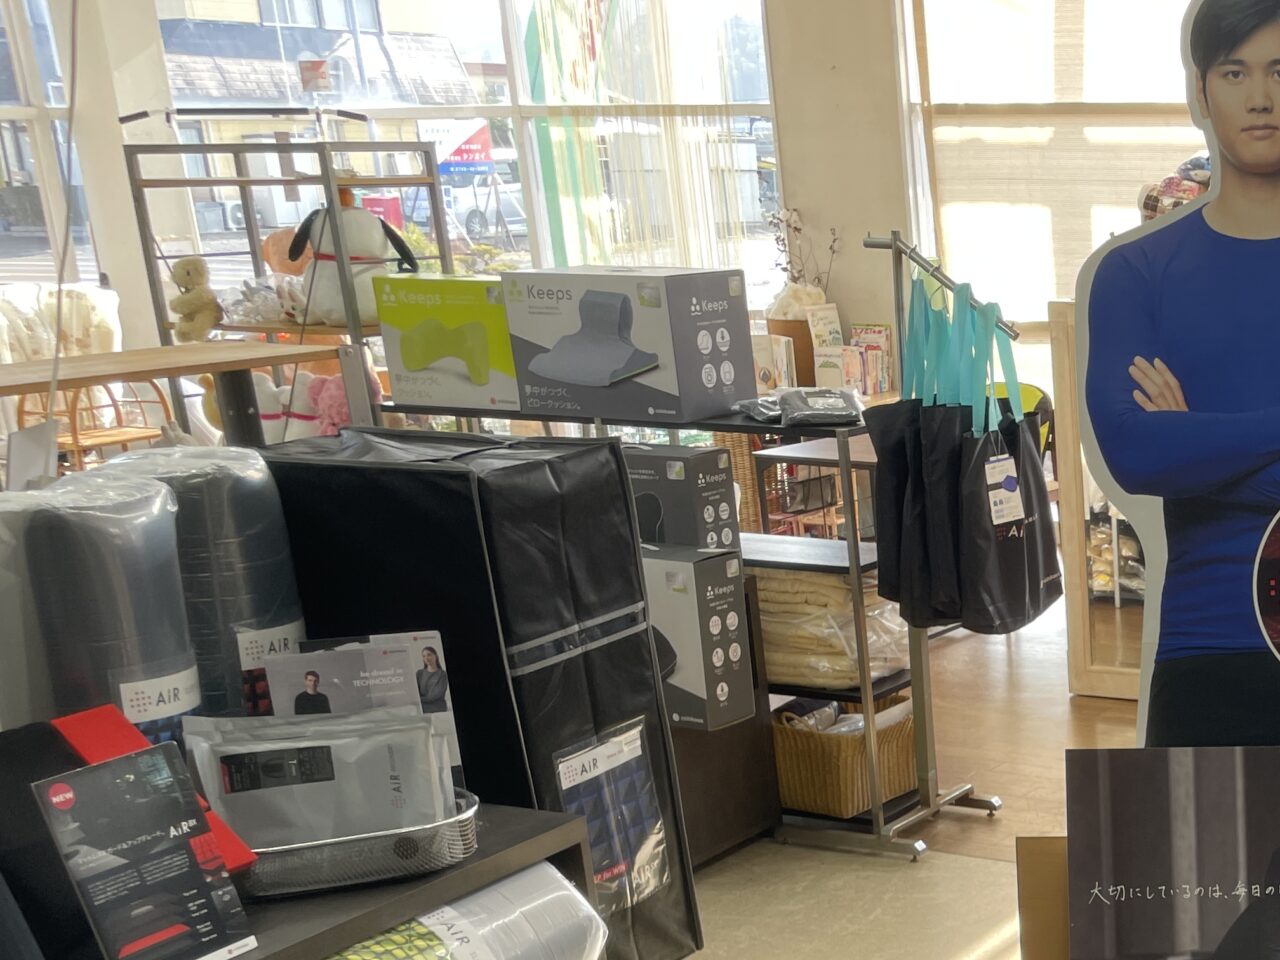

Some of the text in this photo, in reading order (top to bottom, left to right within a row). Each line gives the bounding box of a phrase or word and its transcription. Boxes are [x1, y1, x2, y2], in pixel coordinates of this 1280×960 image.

[399, 289, 442, 309] Keeps
[526, 284, 573, 304] Keeps
[701, 300, 729, 312] Keeps
[705, 473, 727, 484] Keeps
[714, 583, 735, 597] Keeps
[51, 790, 74, 805] NEW
